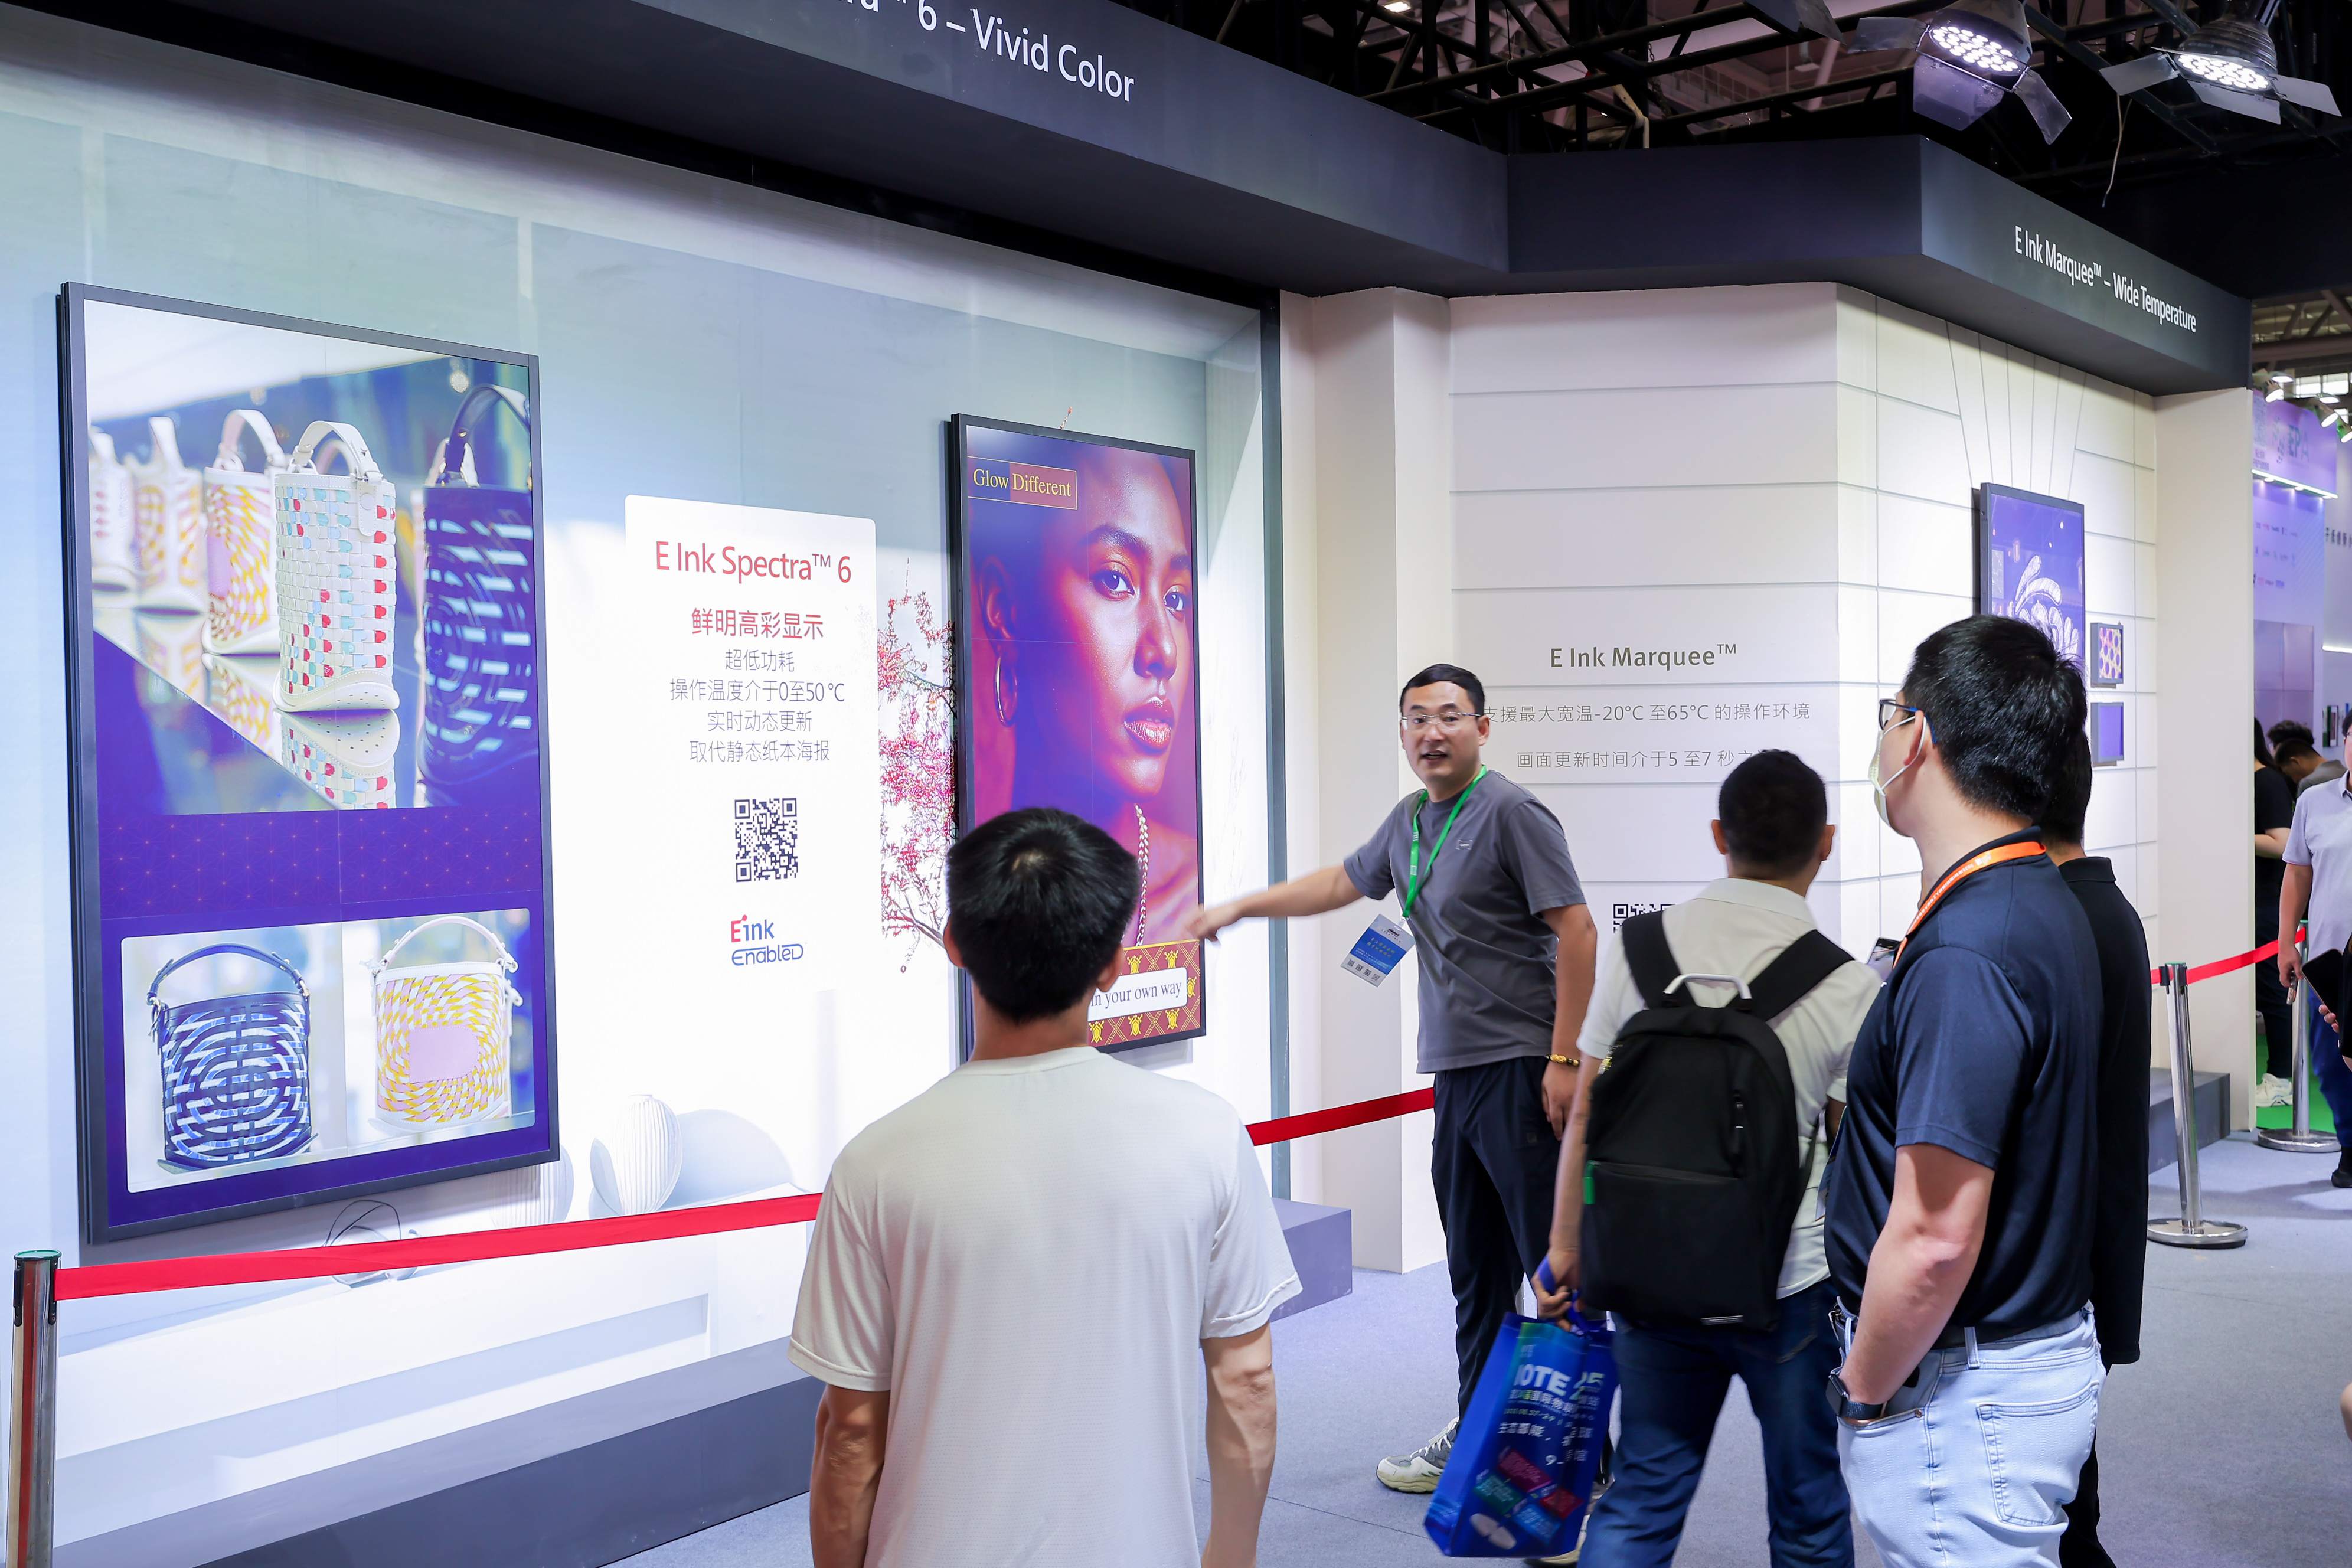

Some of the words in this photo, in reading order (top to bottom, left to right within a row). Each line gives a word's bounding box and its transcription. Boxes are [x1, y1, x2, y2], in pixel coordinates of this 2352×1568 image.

[918, 0, 937, 31] 6
[974, 8, 1048, 72] Vivid
[1059, 44, 1135, 102] Color
[2014, 226, 2023, 254] E
[2025, 230, 2043, 264] Ink
[2045, 240, 2102, 286] Marquee™
[2113, 272, 2139, 307] Wide
[2140, 285, 2196, 333] Temperature
[973, 468, 1009, 489] Glow
[1012, 473, 1072, 497] Different
[656, 541, 669, 570] E
[678, 543, 716, 574] Ink
[721, 546, 831, 584] Spectra™
[838, 556, 851, 583] 6
[691, 607, 824, 641] 鲜明高彩显示
[725, 649, 795, 672] 超低功耗
[1551, 648, 1562, 668] E
[1570, 647, 1606, 667] Ink
[1612, 643, 1737, 671] Marquee™
[708, 710, 812, 732] 实时动态更新
[1649, 705, 1709, 721] 至65°C
[1714, 703, 1810, 721] 的操作环境
[689, 740, 830, 763] 取代静态纸本海报
[1516, 751, 1677, 768] 画面更新时间介于5
[1684, 750, 1711, 767] 至7
[1105, 989, 1132, 1009] your
[1135, 986, 1158, 1000] own
[1161, 982, 1182, 998] way
